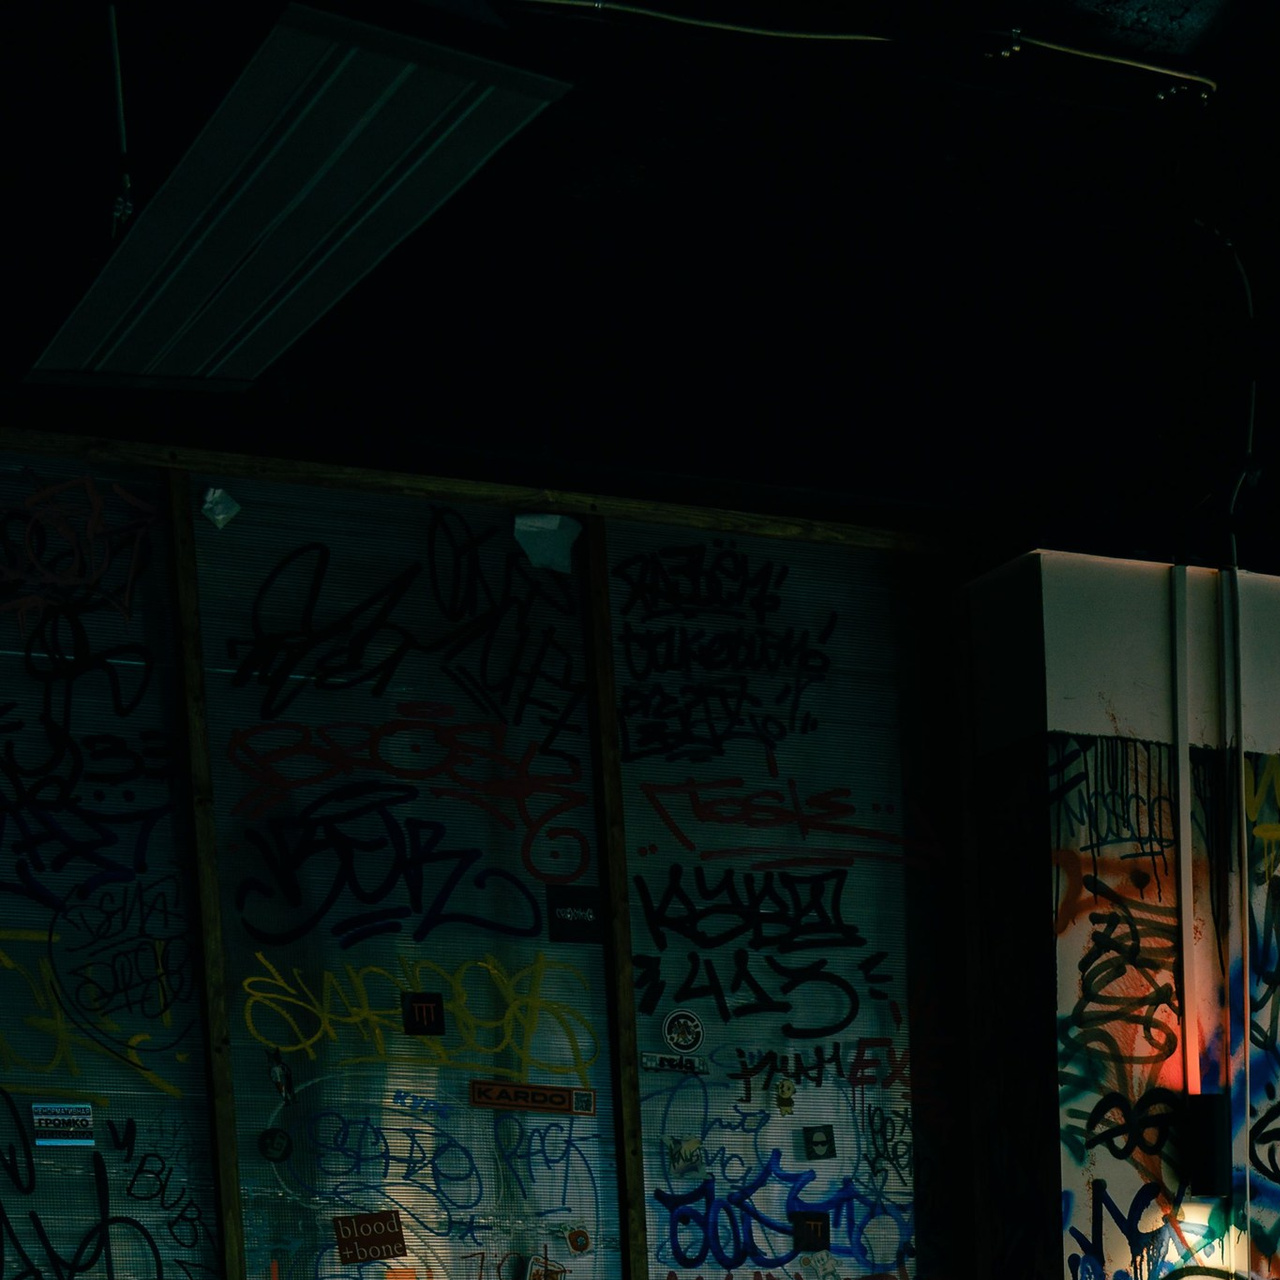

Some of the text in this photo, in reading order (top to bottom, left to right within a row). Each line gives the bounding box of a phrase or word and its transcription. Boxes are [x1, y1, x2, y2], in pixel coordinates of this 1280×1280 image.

[477, 1086, 567, 1106] KARDO
[38, 1118, 89, 1128] ГРОМКО
[338, 1213, 400, 1240] blood
[342, 1241, 405, 1262] +bone
